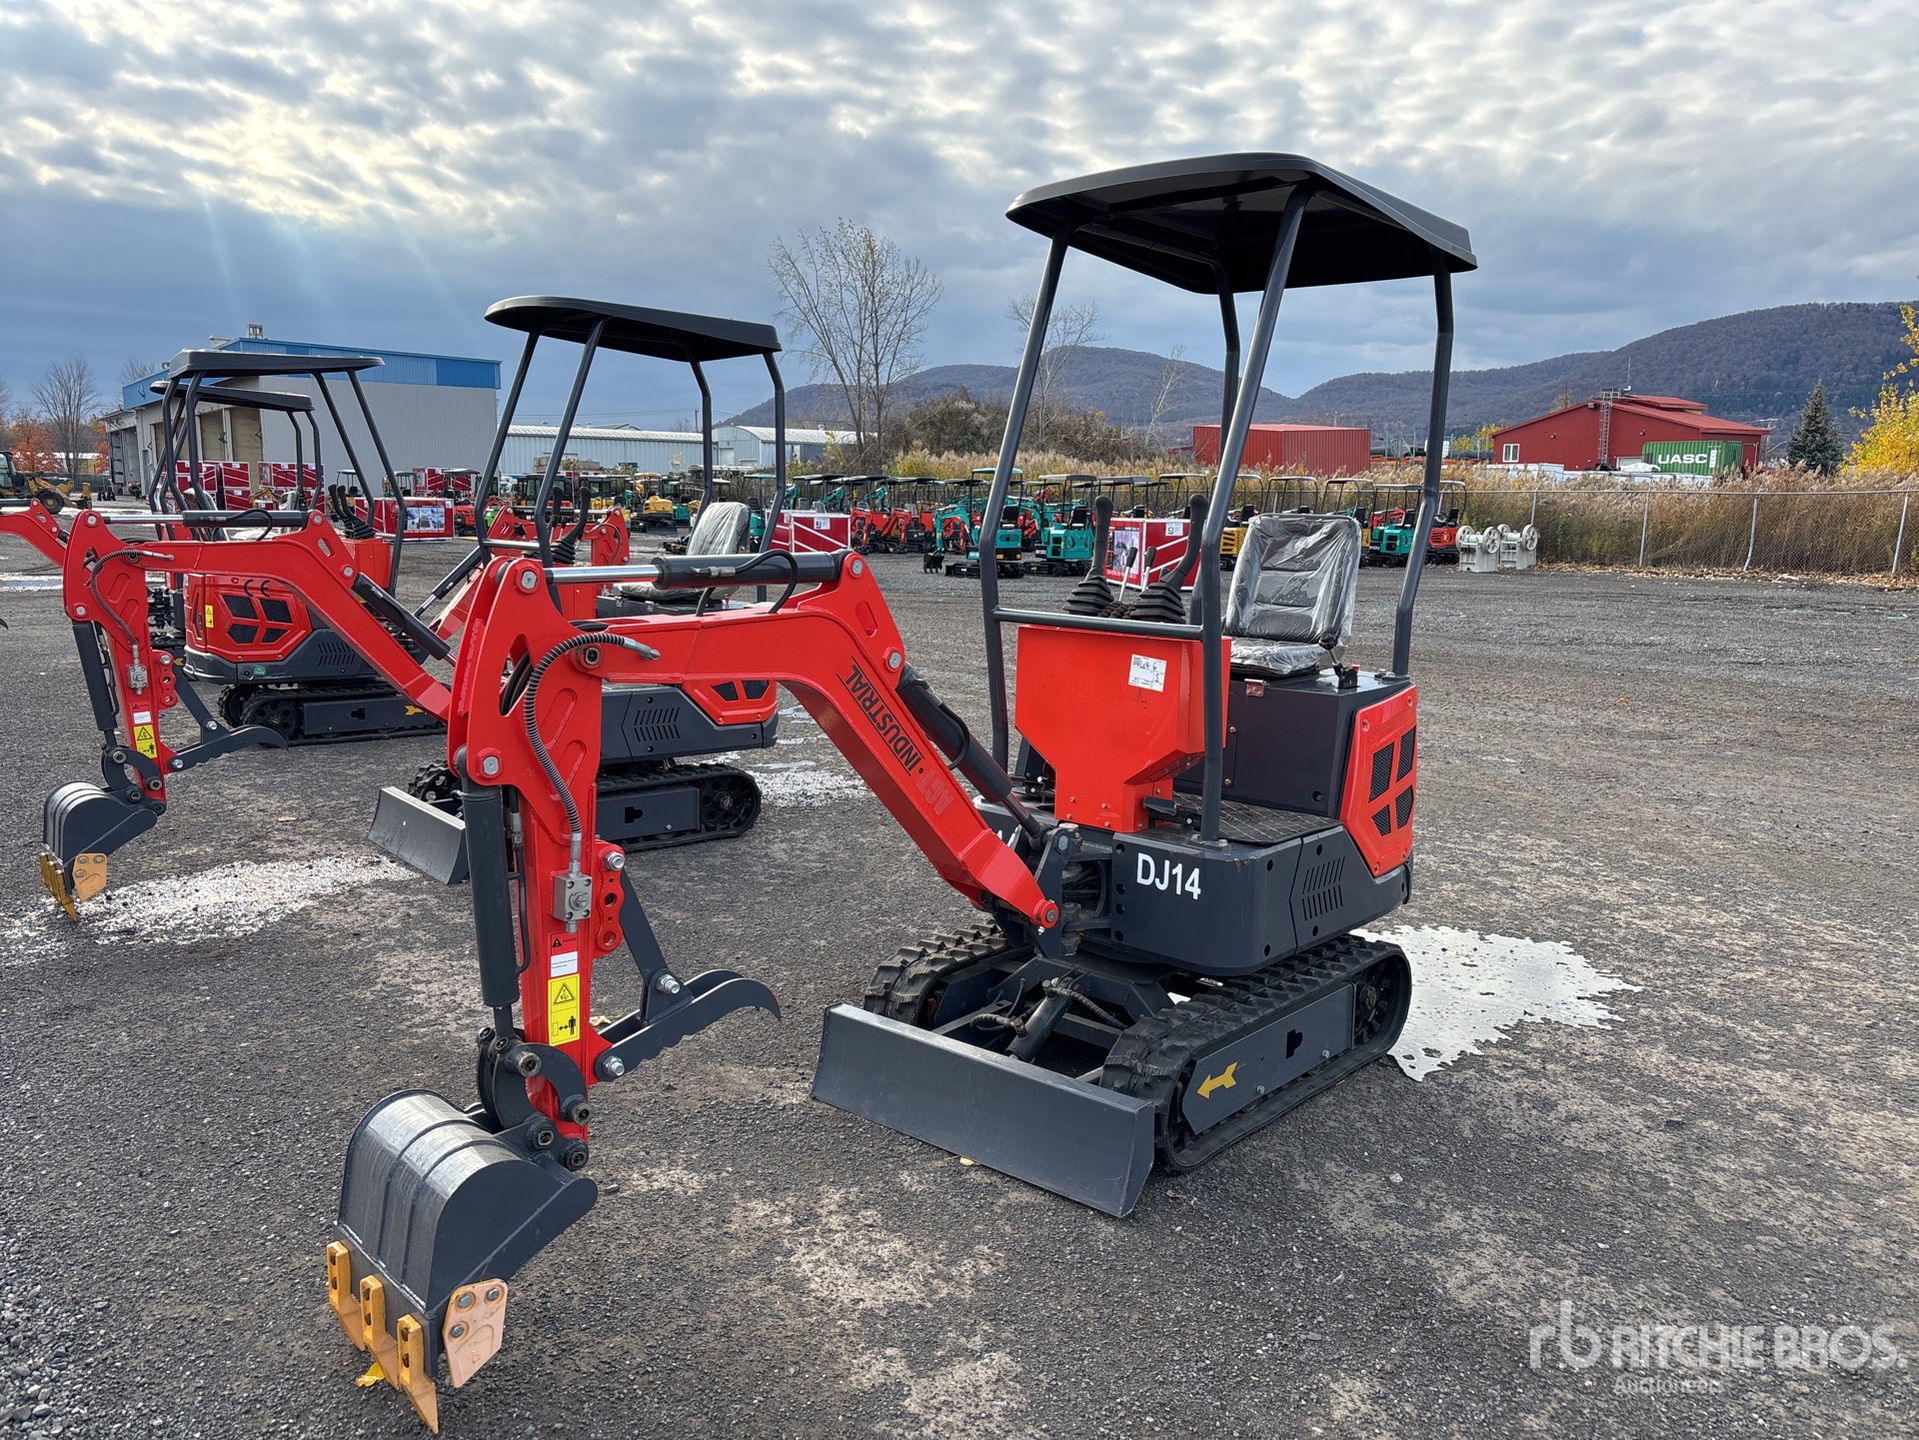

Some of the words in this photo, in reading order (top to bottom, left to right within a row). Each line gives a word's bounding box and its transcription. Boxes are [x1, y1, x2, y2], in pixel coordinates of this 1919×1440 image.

[1657, 453, 1708, 465] UASC
[844, 664, 924, 772] INDUSTRIAL
[1136, 852, 1202, 900] DJ14
